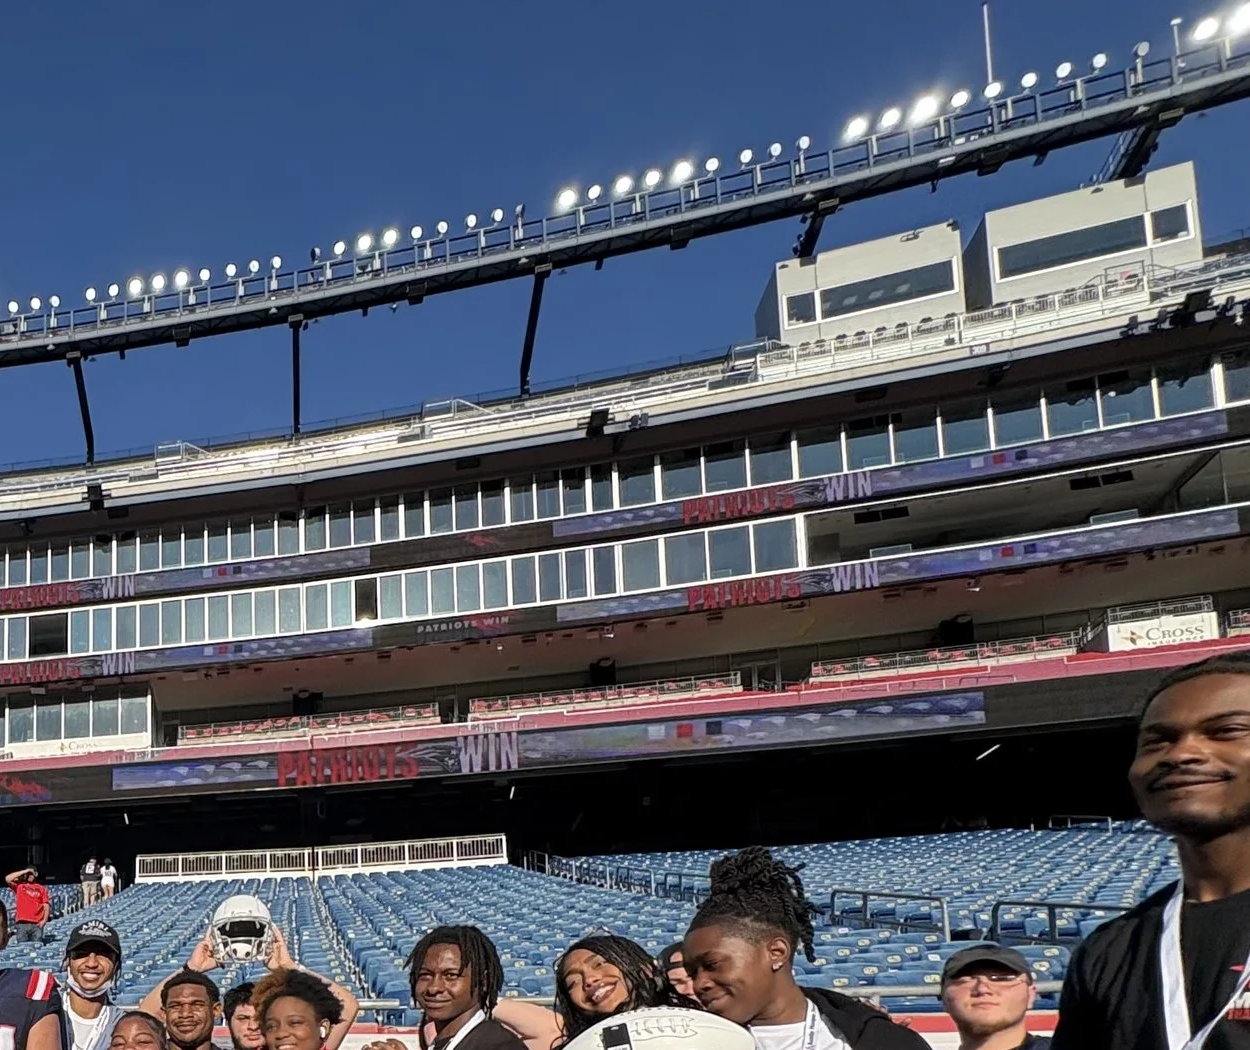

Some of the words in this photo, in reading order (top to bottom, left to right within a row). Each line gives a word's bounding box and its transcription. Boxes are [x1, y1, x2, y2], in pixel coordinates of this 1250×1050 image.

[682, 486, 795, 524] PATRIOTS
[824, 471, 871, 501] WIN
[102, 575, 135, 599] WIN
[687, 573, 802, 611] PATRIOTS
[831, 561, 879, 592] WIN
[417, 620, 477, 633] PATRIOTS
[483, 616, 509, 625] WIN
[1145, 625, 1204, 641] CROSS
[102, 652, 135, 676] WIN
[277, 742, 419, 787] PATRIOTS
[457, 732, 518, 773] WIN
